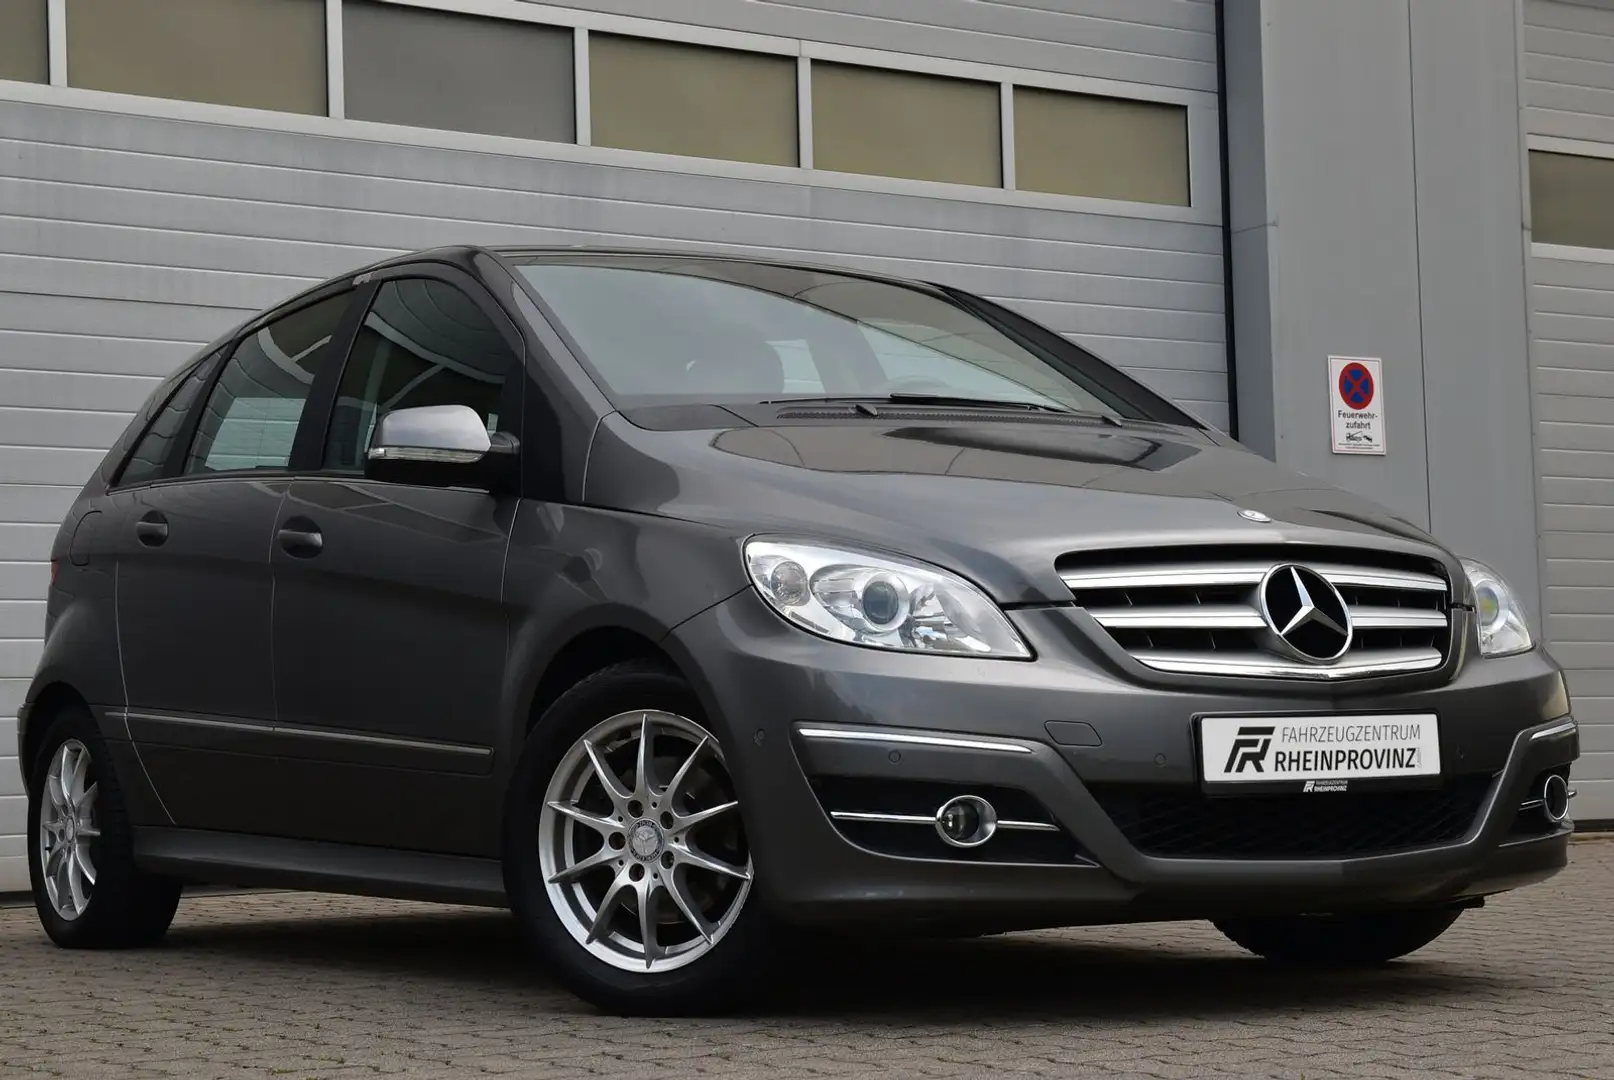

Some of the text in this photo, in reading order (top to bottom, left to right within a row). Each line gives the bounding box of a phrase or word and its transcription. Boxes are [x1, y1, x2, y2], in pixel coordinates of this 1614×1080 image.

[1338, 410, 1378, 419] Feuerwehr-
[1346, 421, 1371, 429] zufahrt
[1282, 724, 1421, 743] FAHRZEUGZENTRUM
[1275, 748, 1416, 772] RHEINPROVINZ
